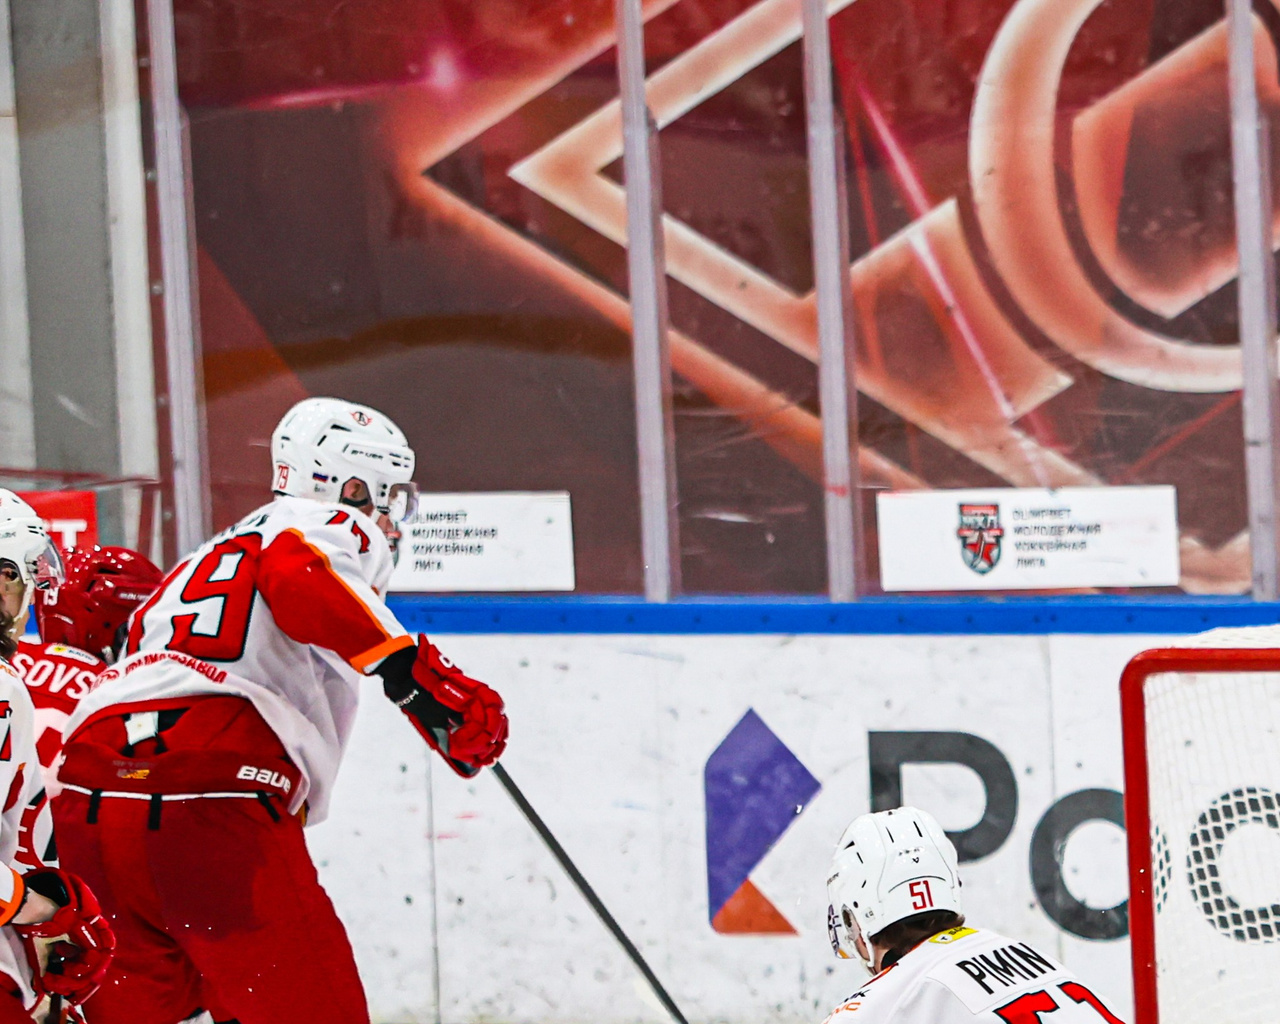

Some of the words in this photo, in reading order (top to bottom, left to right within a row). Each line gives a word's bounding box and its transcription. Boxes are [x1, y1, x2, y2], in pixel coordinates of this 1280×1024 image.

[10, 654, 93, 701] SOVS
[235, 764, 293, 794] BAUE
[908, 879, 934, 911] 51
[955, 941, 1057, 996] PIMIN
